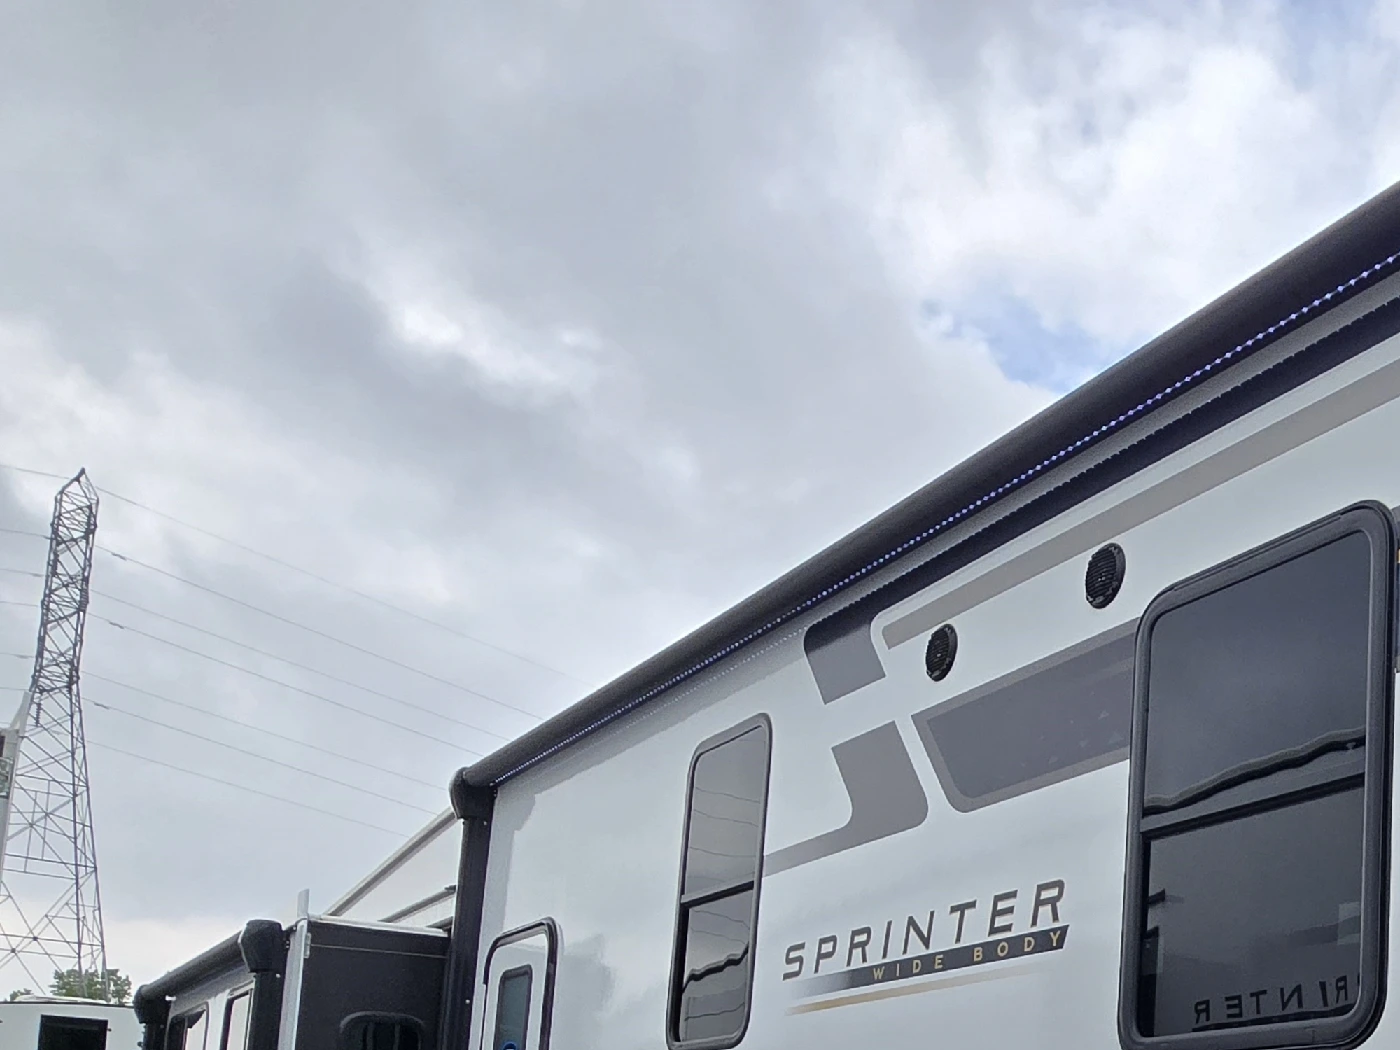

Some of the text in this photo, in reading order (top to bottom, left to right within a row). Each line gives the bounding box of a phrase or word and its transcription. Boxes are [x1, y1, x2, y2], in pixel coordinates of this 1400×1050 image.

[781, 879, 1066, 980] SPRINTER
[872, 930, 1062, 980] WIDE BODY
